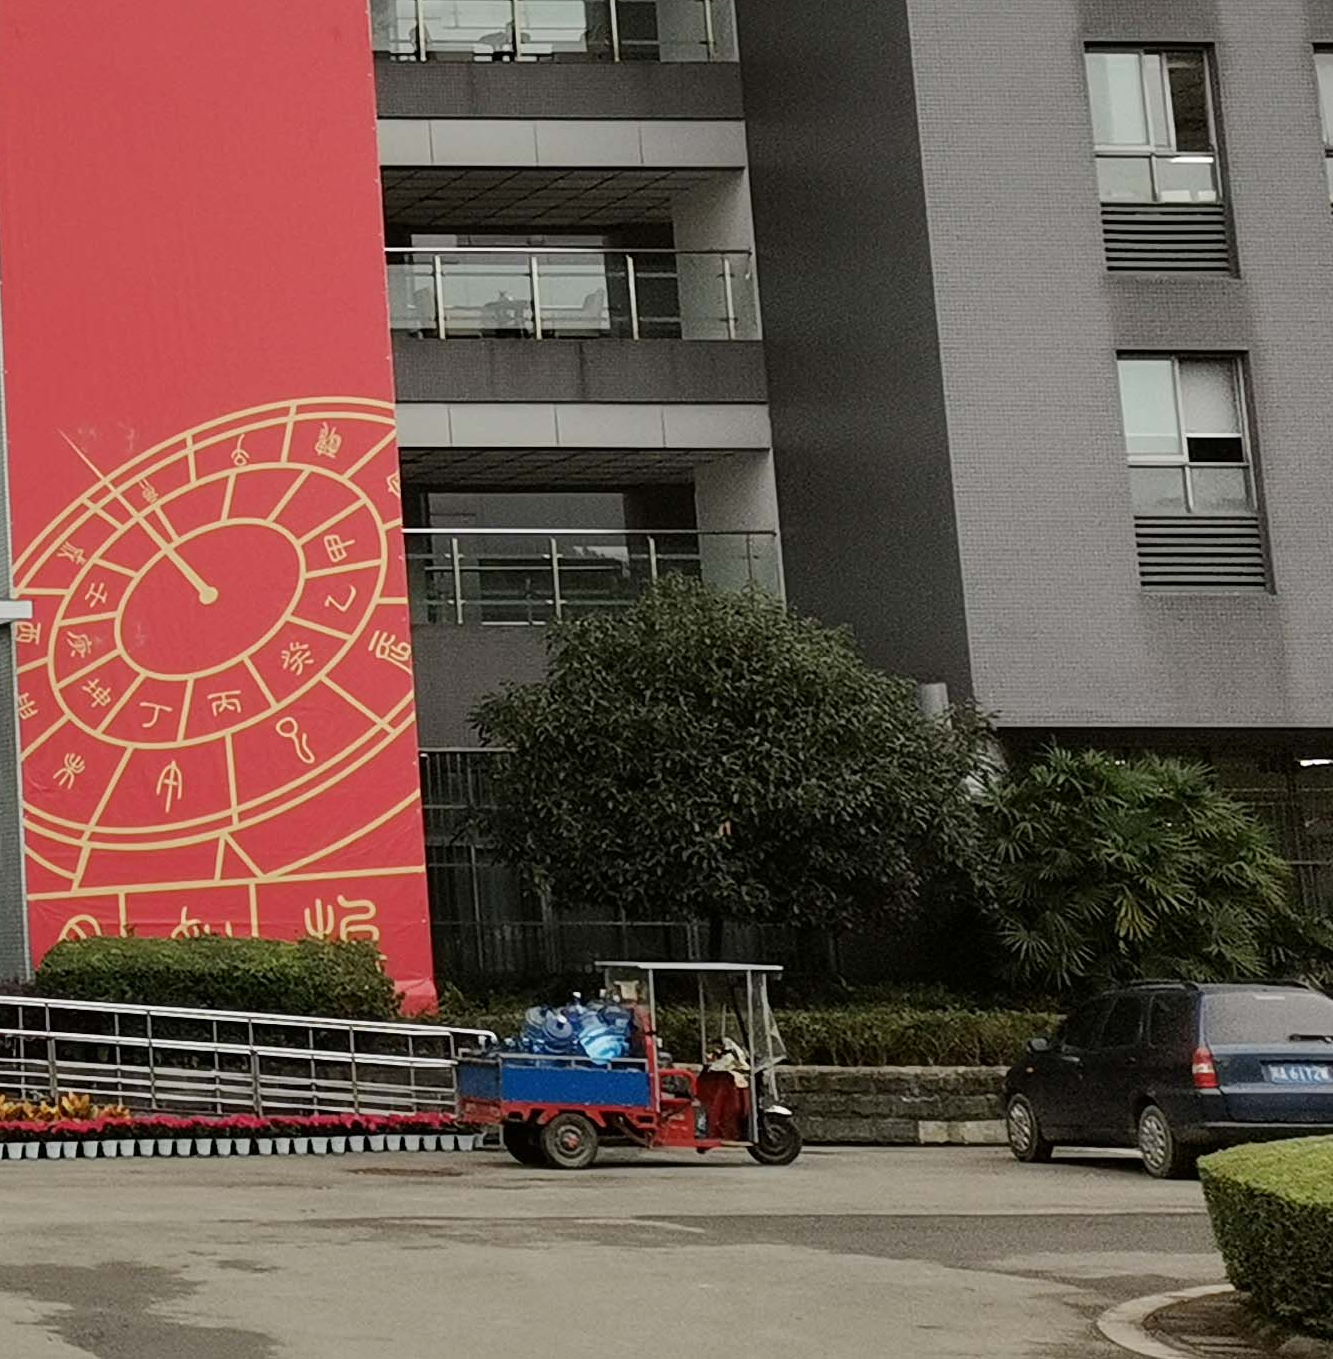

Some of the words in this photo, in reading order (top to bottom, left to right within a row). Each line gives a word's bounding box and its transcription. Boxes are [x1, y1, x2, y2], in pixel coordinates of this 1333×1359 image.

[323, 534, 356, 562] 甲
[139, 701, 173, 728] 丁
[207, 690, 242, 717] 丙
